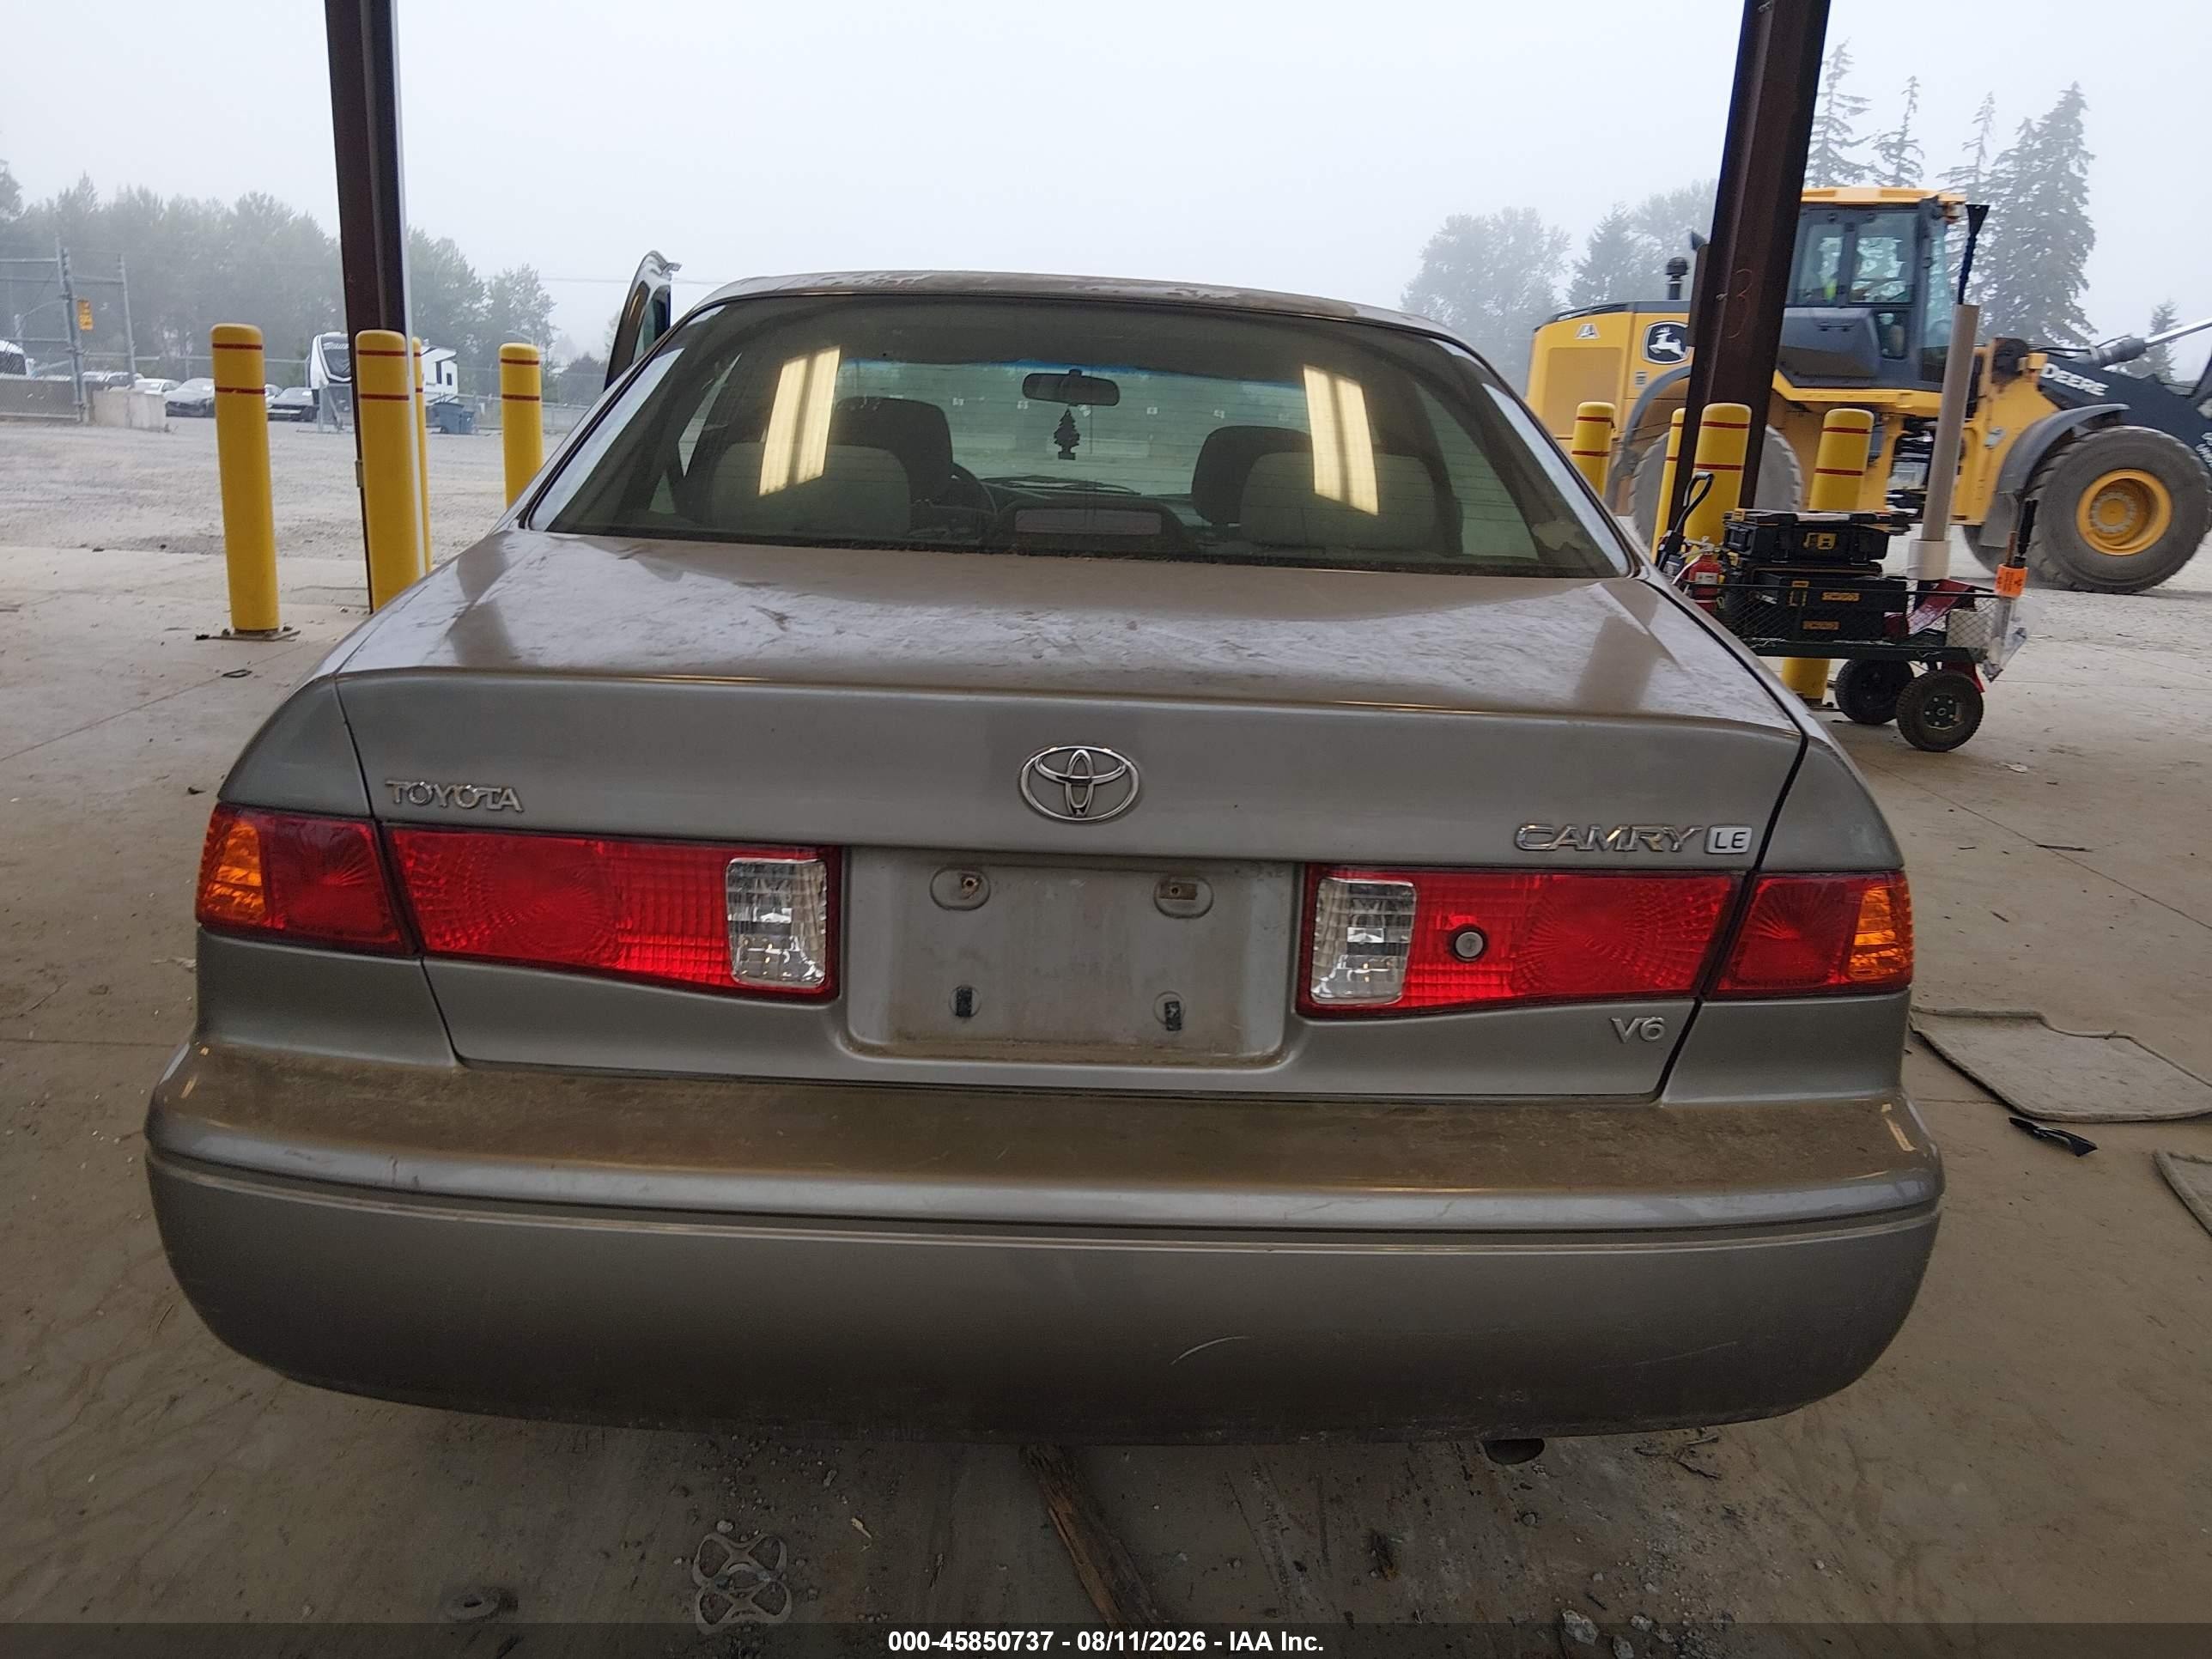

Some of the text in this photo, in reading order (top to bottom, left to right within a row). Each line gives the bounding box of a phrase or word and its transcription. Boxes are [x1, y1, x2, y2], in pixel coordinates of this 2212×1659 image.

[2040, 362, 2110, 397] DEERE
[385, 779, 525, 813] TOYOTA
[1514, 823, 1748, 853] CAMRY LE
[1609, 1016, 1665, 1044] V6
